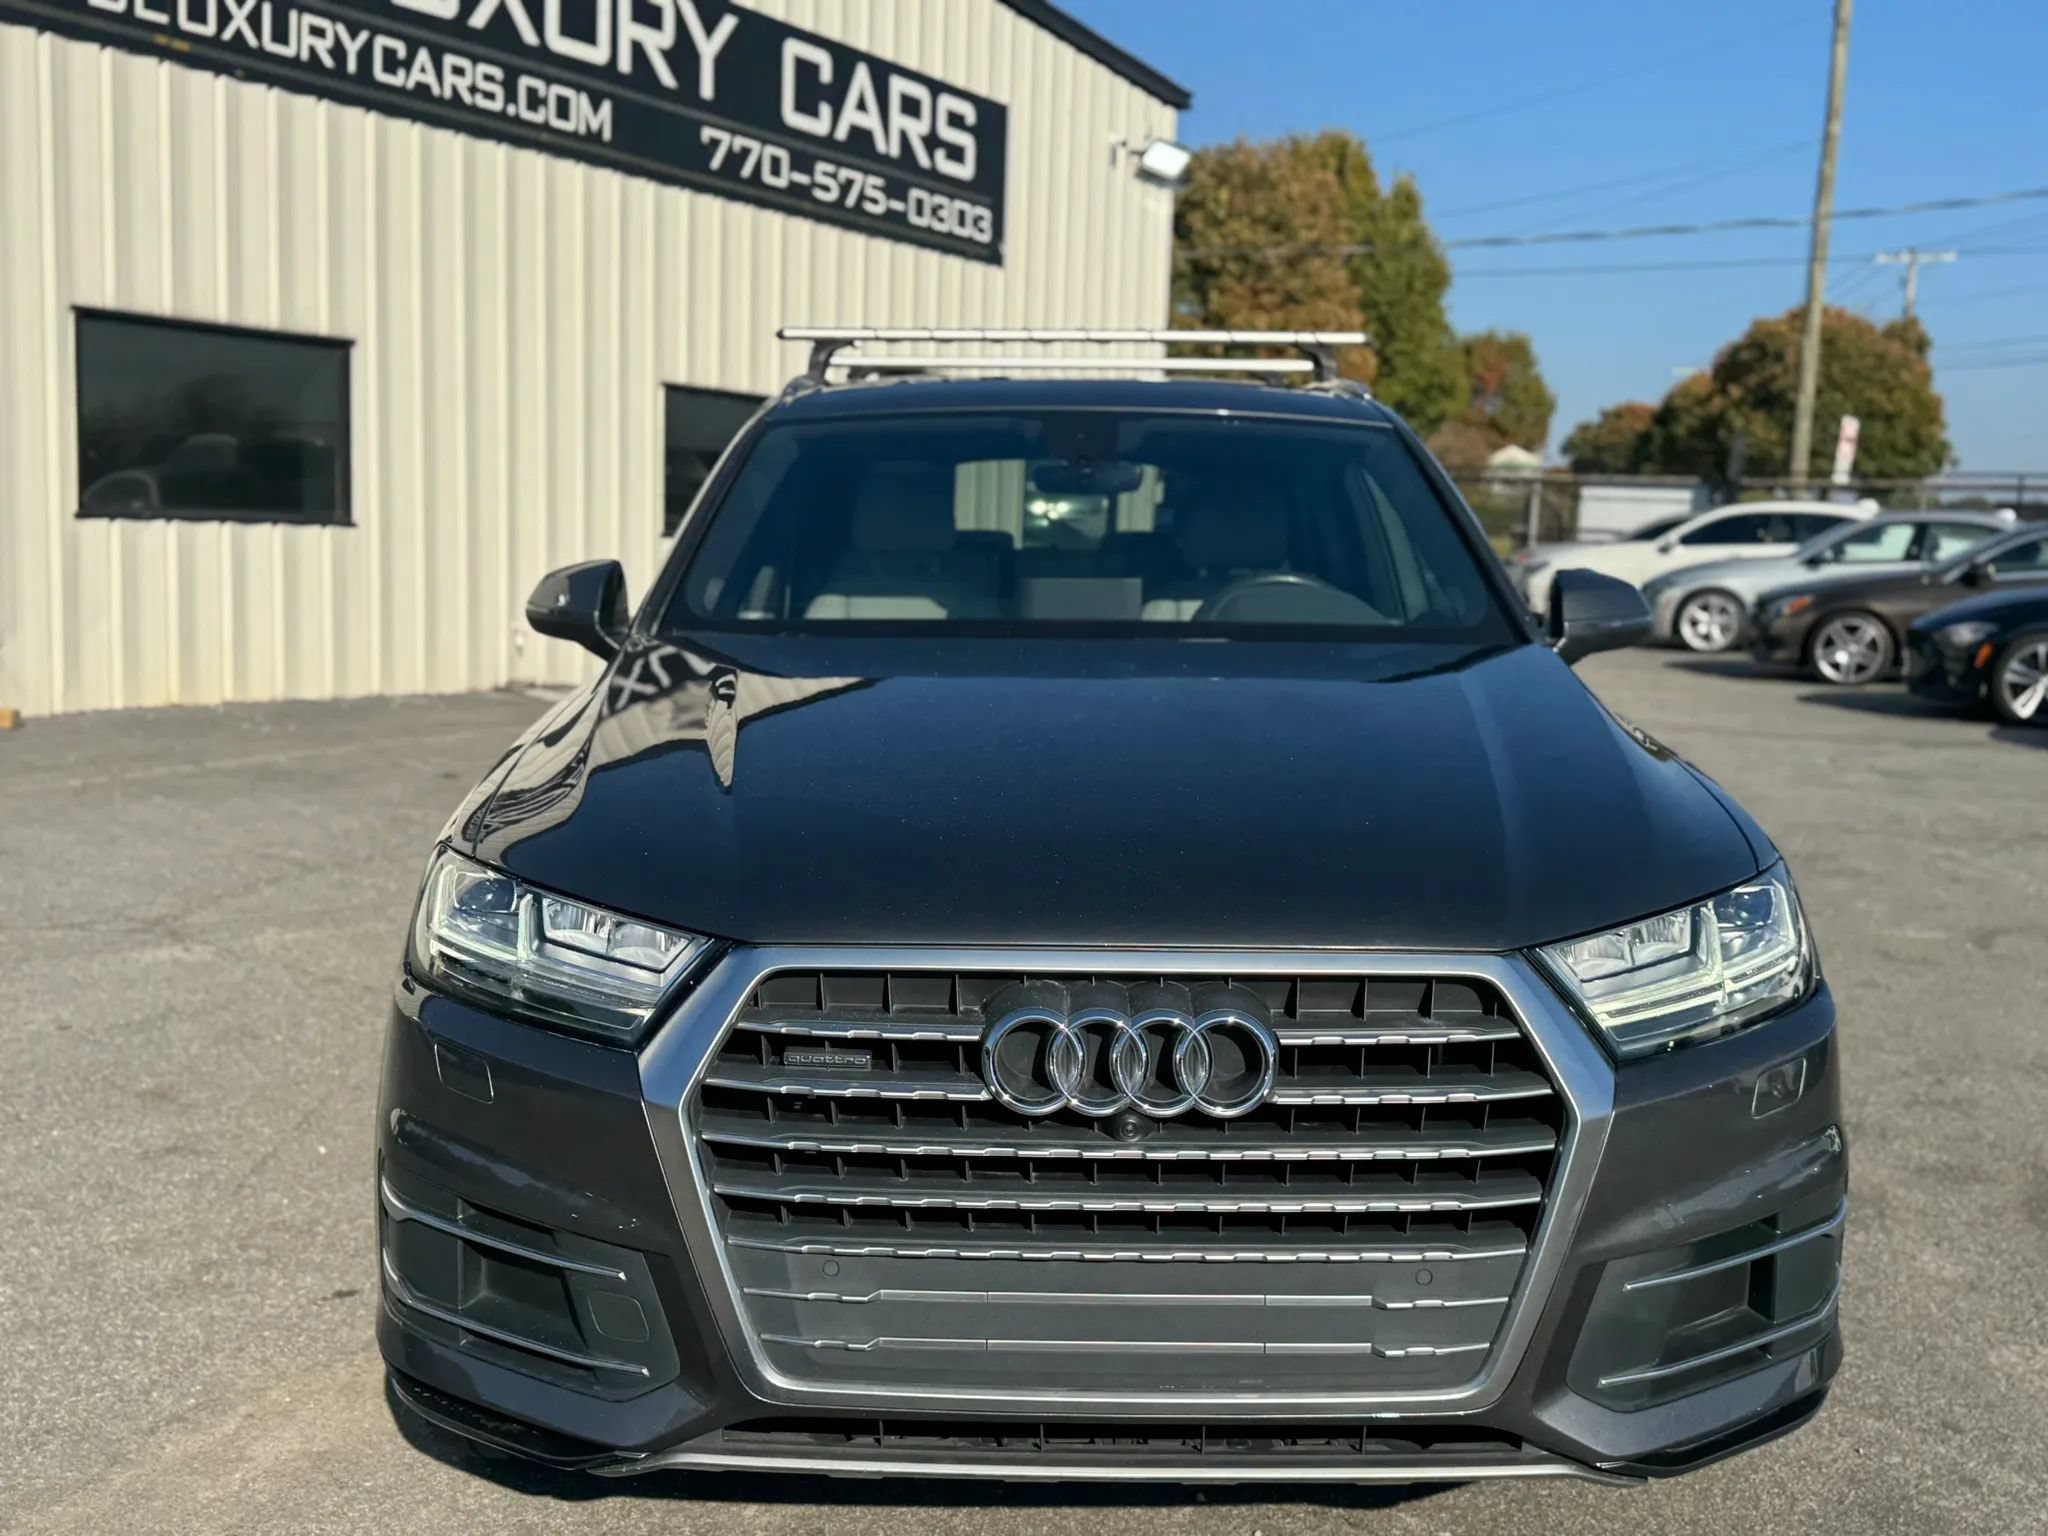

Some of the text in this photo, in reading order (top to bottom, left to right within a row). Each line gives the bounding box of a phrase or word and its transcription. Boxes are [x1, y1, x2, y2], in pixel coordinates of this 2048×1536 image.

[782, 38, 977, 181] CARS
[701, 126, 993, 244] 770-575-0303
[788, 1054, 866, 1065] quattro
